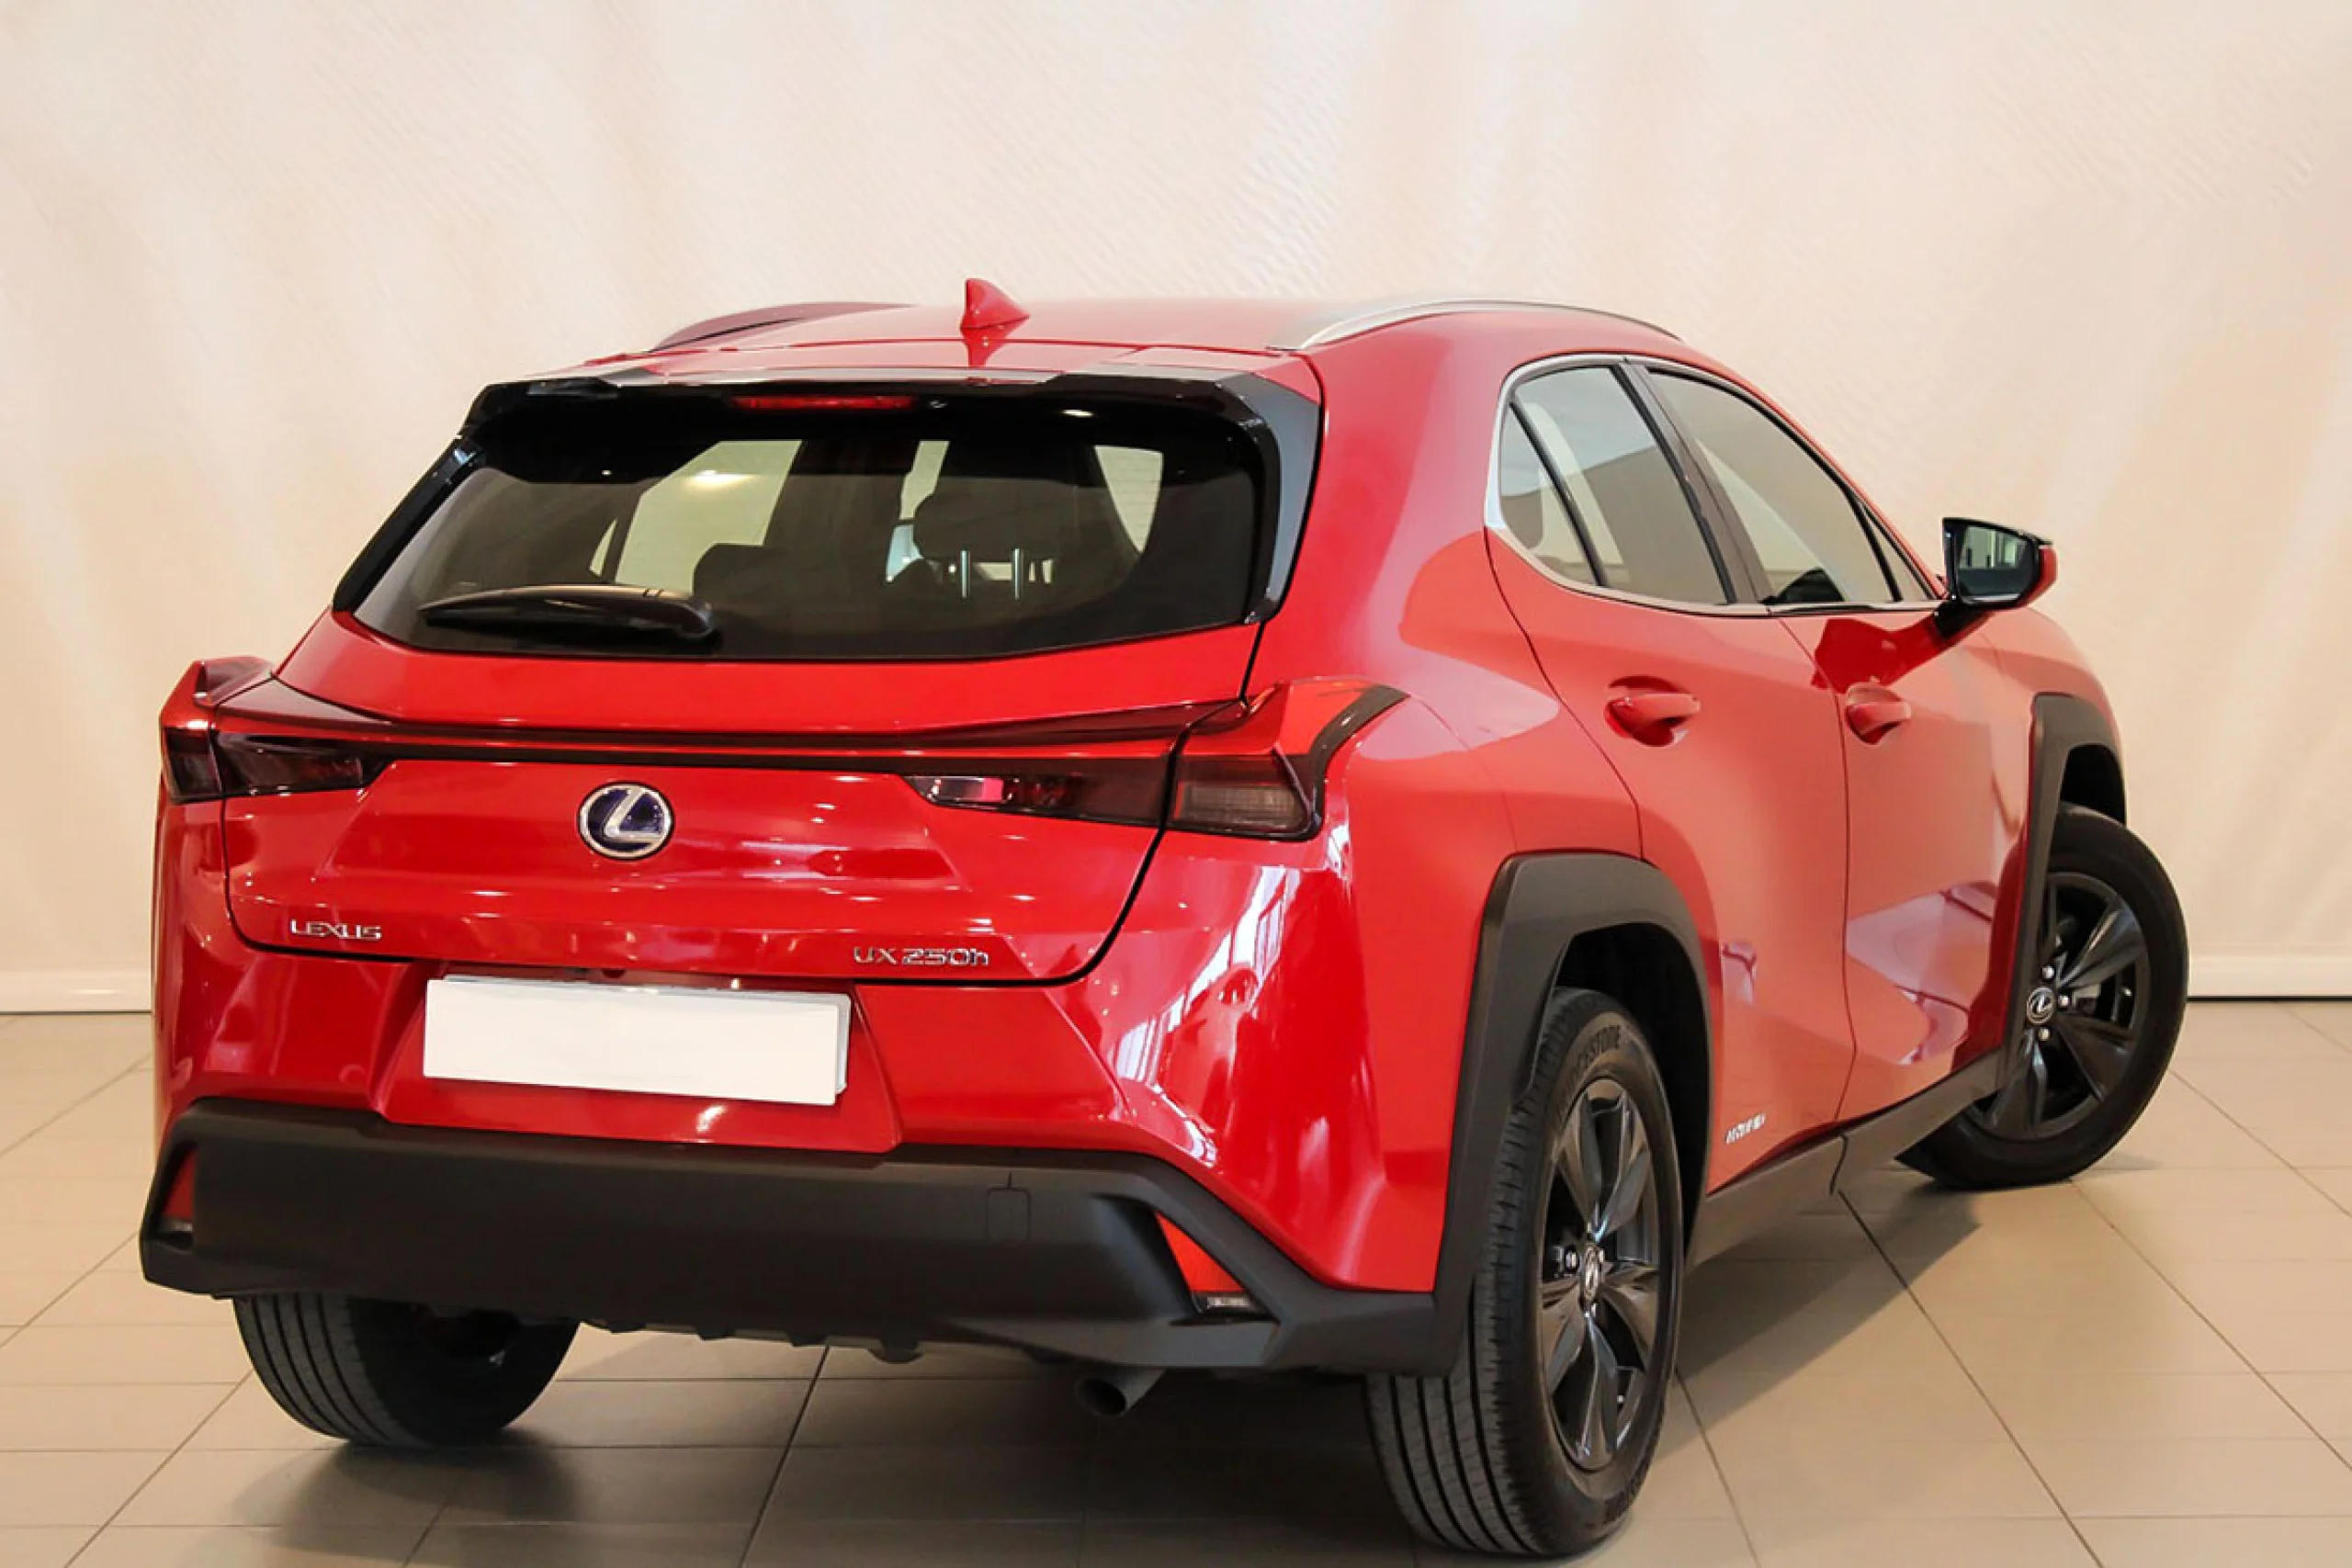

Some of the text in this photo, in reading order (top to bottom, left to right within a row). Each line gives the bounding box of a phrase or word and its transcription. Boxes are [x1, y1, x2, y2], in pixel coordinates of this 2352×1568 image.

[290, 919, 382, 940] LEXUS
[854, 947, 989, 966] UX 250h
